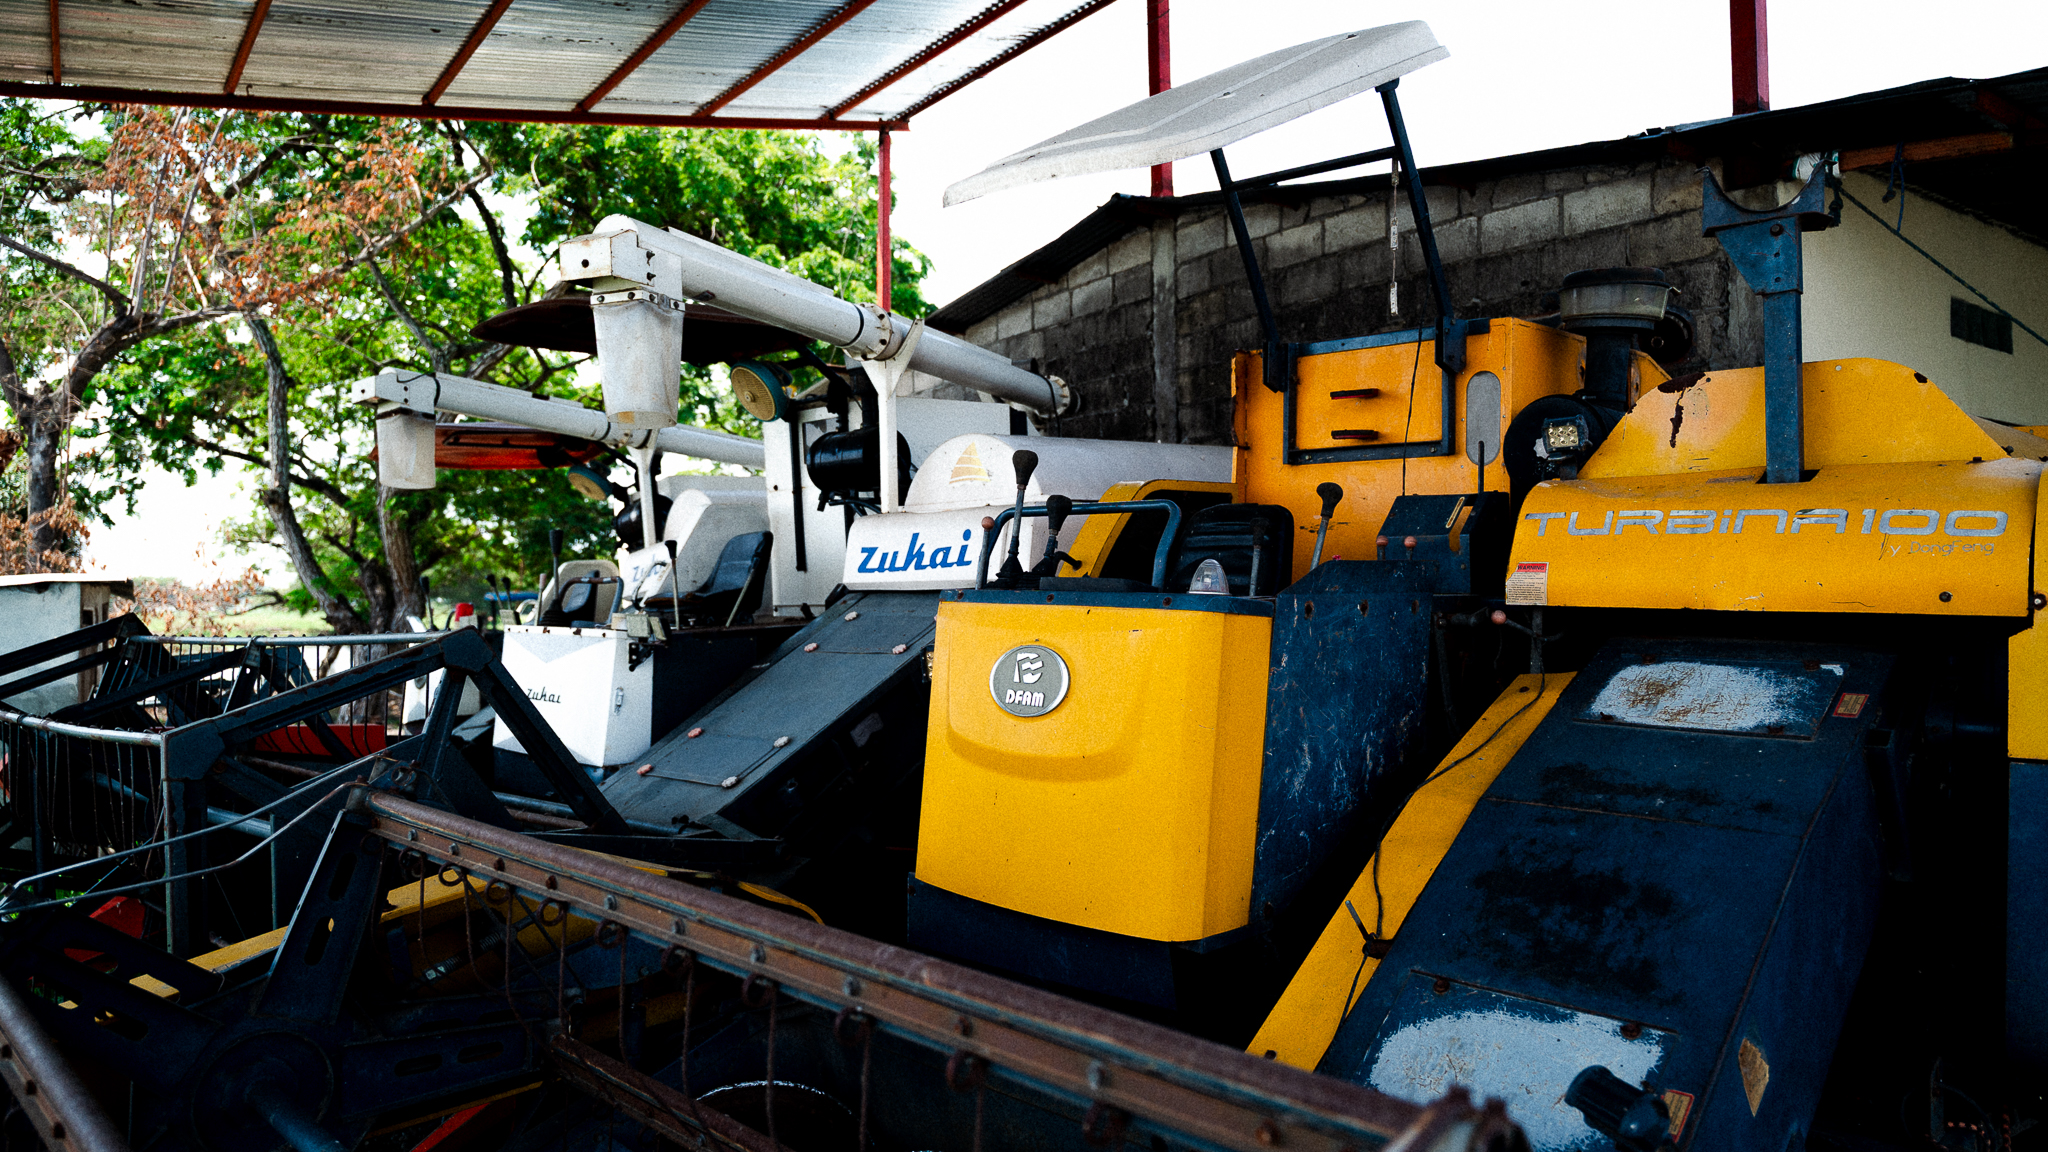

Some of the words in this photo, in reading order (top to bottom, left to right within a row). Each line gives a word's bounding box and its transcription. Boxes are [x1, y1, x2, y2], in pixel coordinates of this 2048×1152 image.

[857, 529, 973, 574] Zukai
[1910, 540, 1995, 556] DongFeng
[1005, 689, 1045, 708] DFAM
